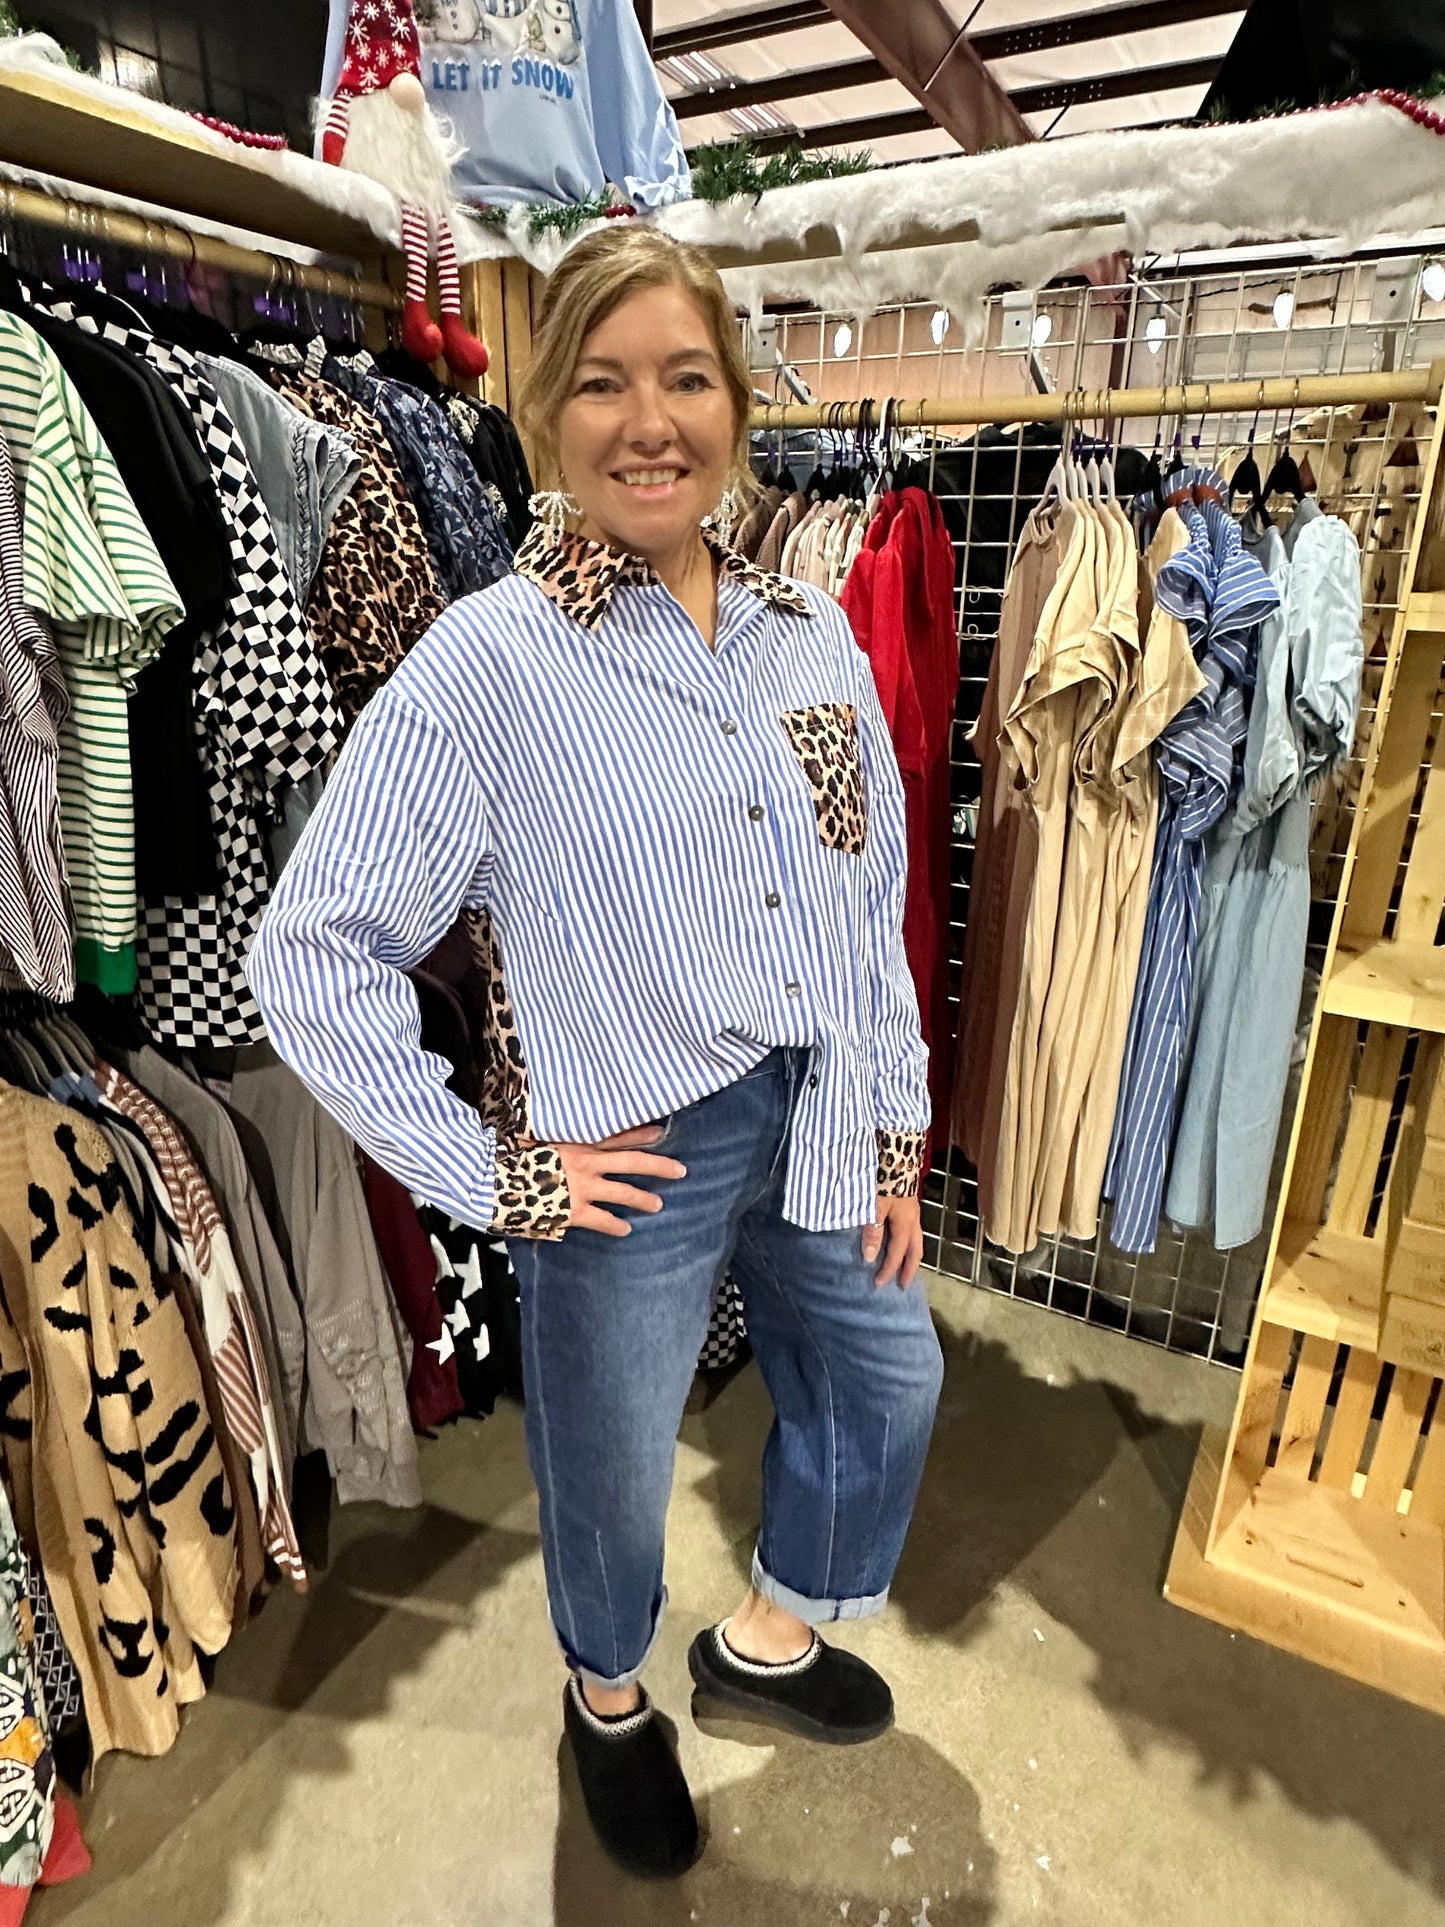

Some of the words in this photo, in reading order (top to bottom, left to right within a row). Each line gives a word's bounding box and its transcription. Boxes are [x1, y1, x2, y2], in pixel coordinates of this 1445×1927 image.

[432, 58, 470, 91] LET
[482, 59, 502, 91] IT
[511, 53, 574, 99] SNOW
